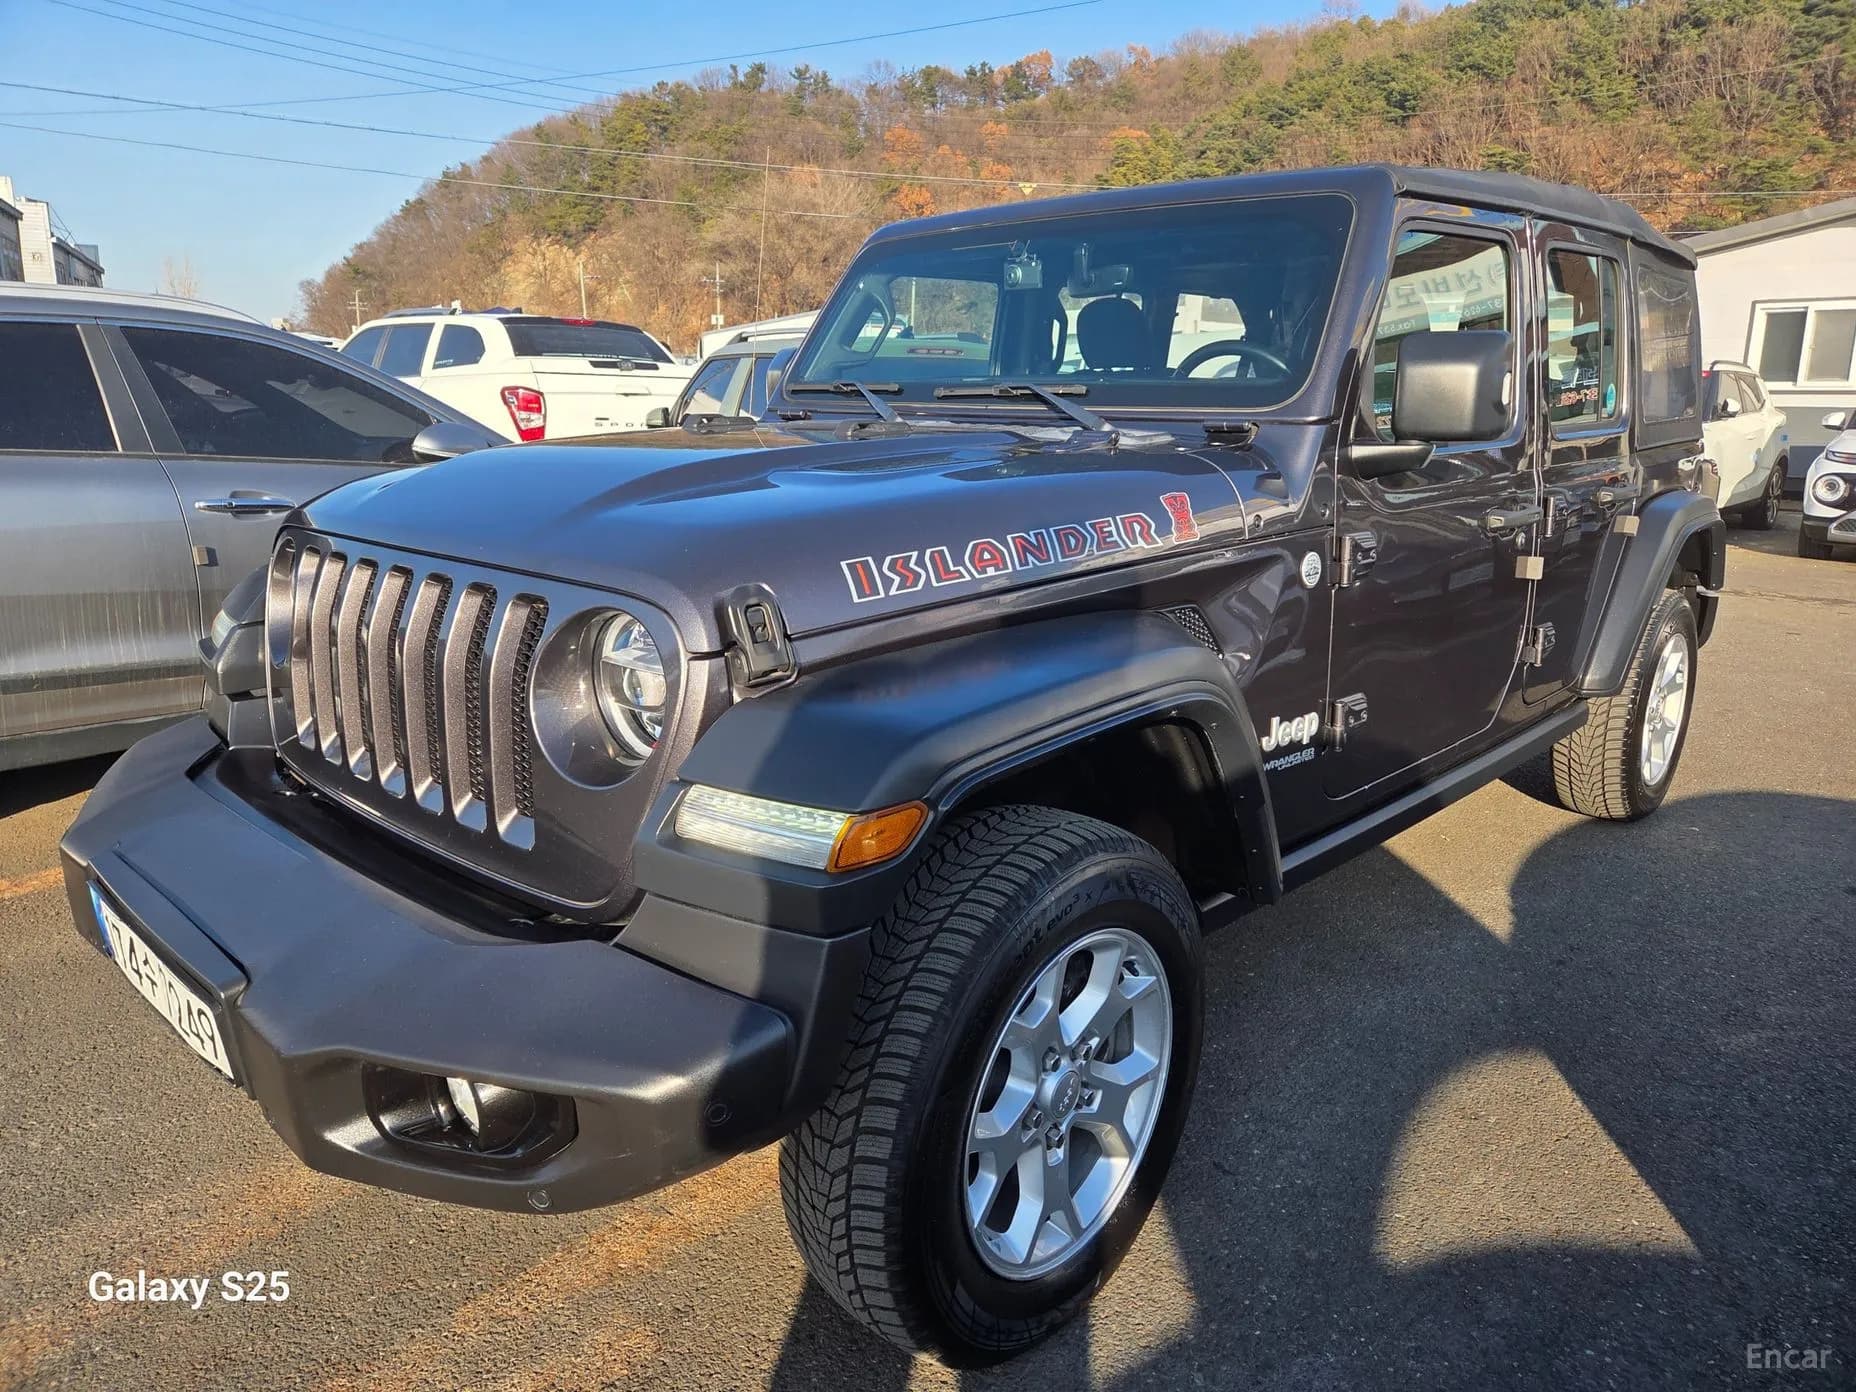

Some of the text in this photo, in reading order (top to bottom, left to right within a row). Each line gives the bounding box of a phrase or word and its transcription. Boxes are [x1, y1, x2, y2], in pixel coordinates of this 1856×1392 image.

[840, 512, 1161, 602] ISLANDER
[1261, 711, 1319, 752] Jeep
[1263, 747, 1315, 771] WRANGLER
